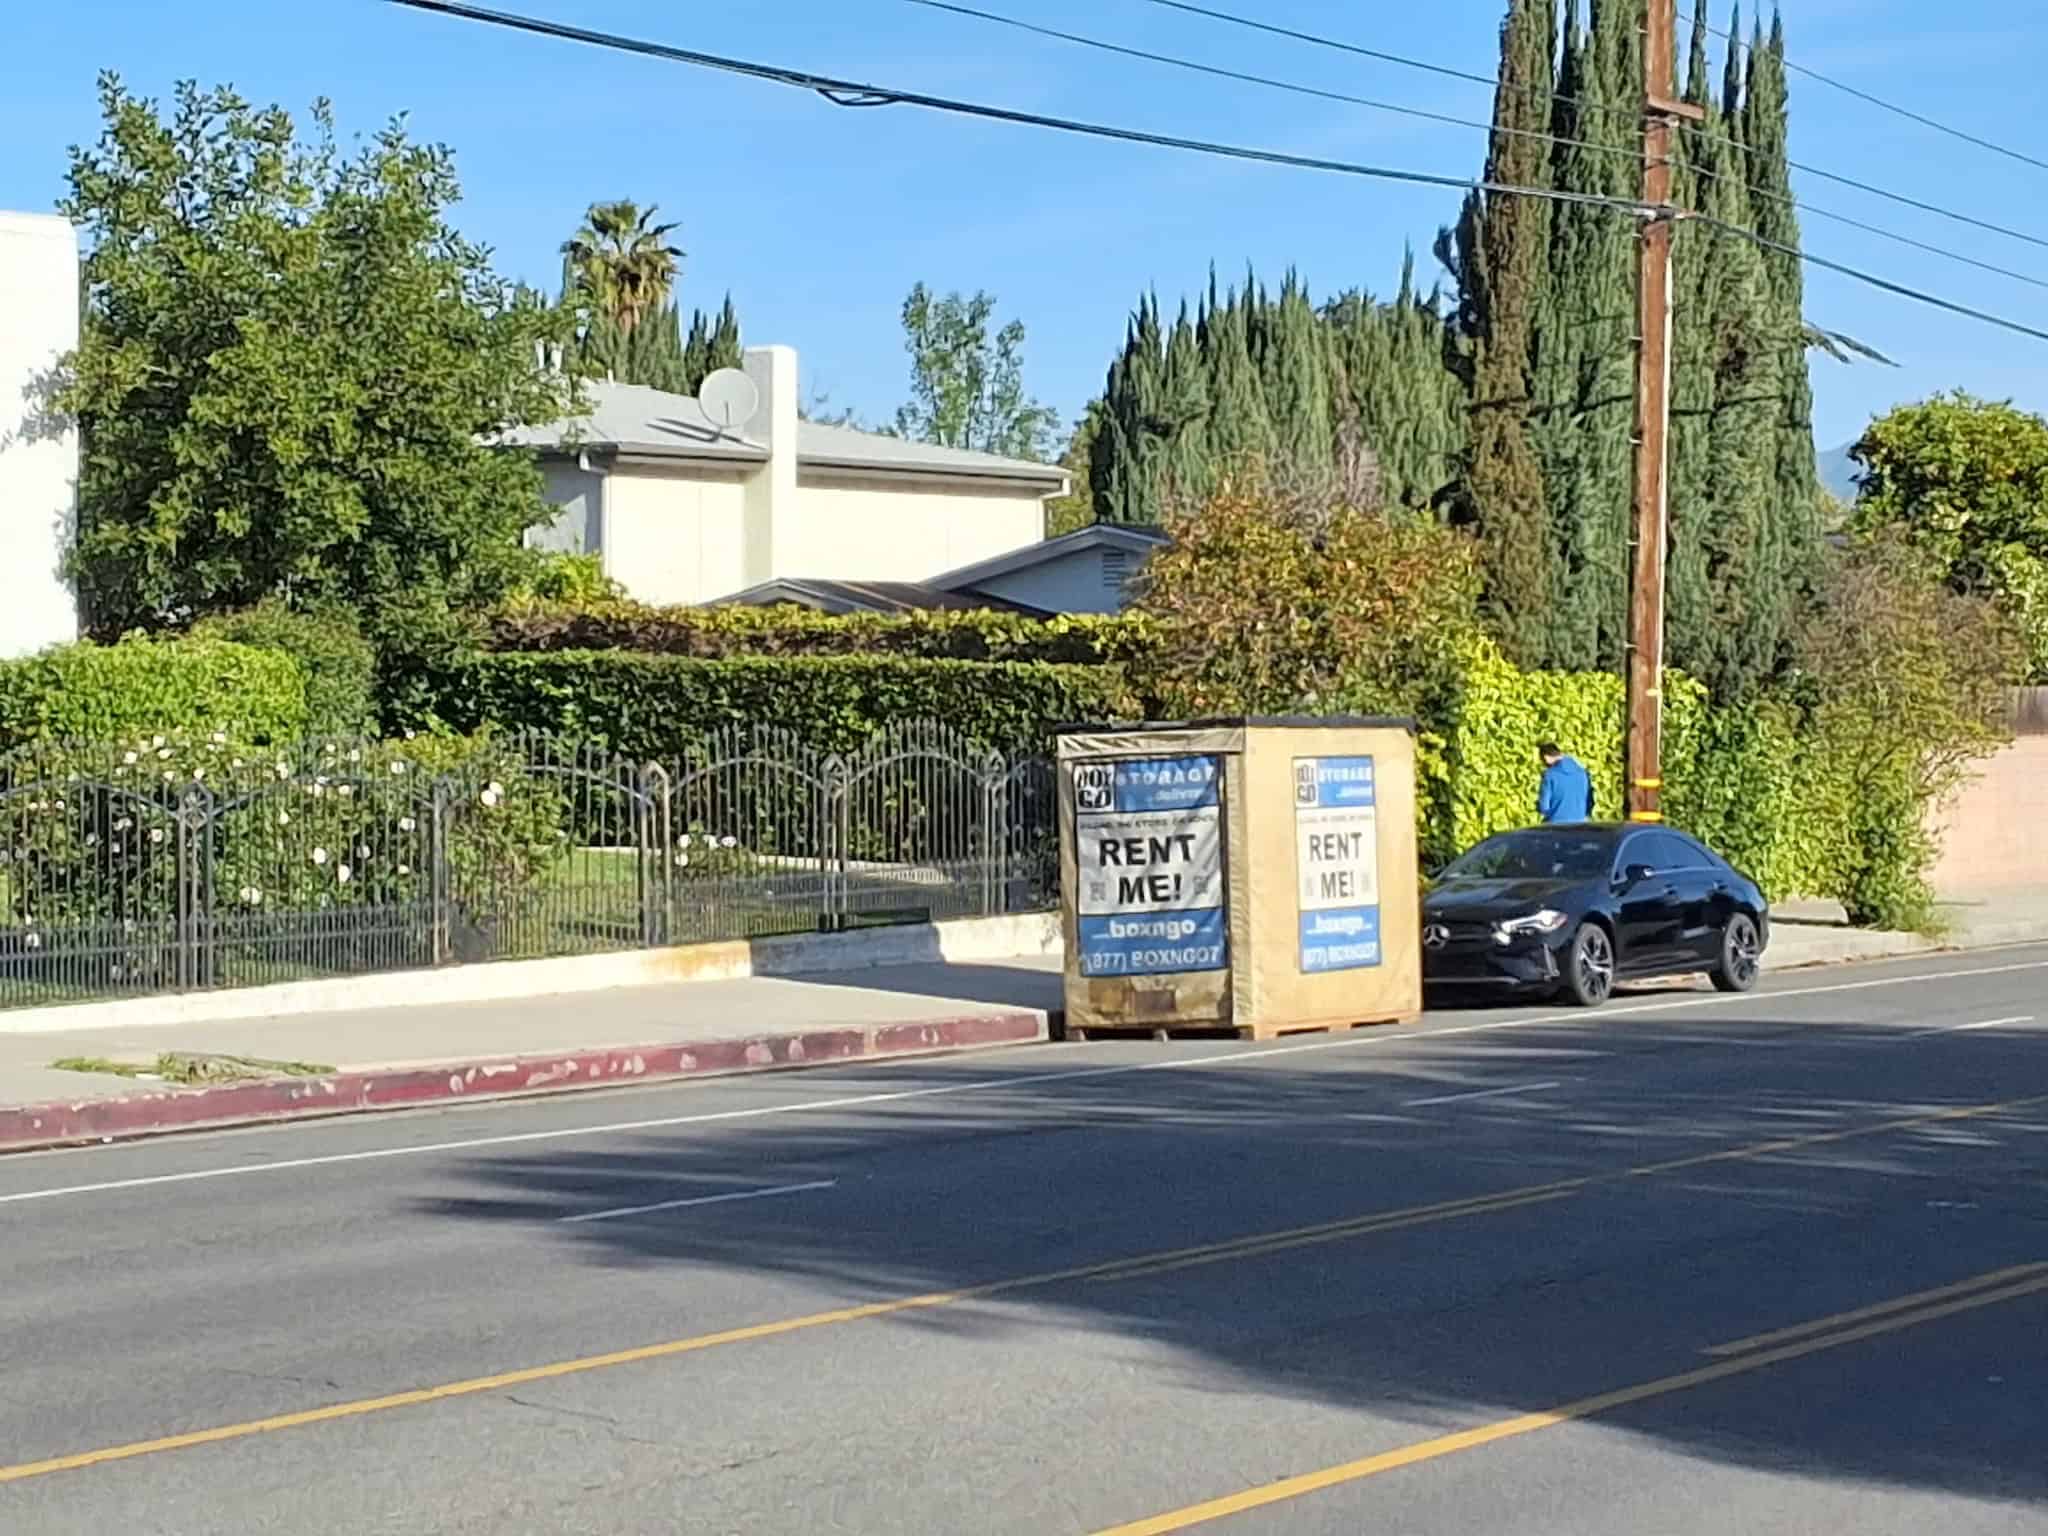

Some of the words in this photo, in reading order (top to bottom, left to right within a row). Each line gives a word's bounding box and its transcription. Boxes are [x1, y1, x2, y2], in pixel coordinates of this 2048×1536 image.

[1077, 790, 1112, 809] GO
[1099, 833, 1196, 866] RENT
[1308, 831, 1363, 862] RENT
[1118, 873, 1182, 904] ME!
[1320, 870, 1355, 900] ME!
[1108, 918, 1196, 941] boxngo
